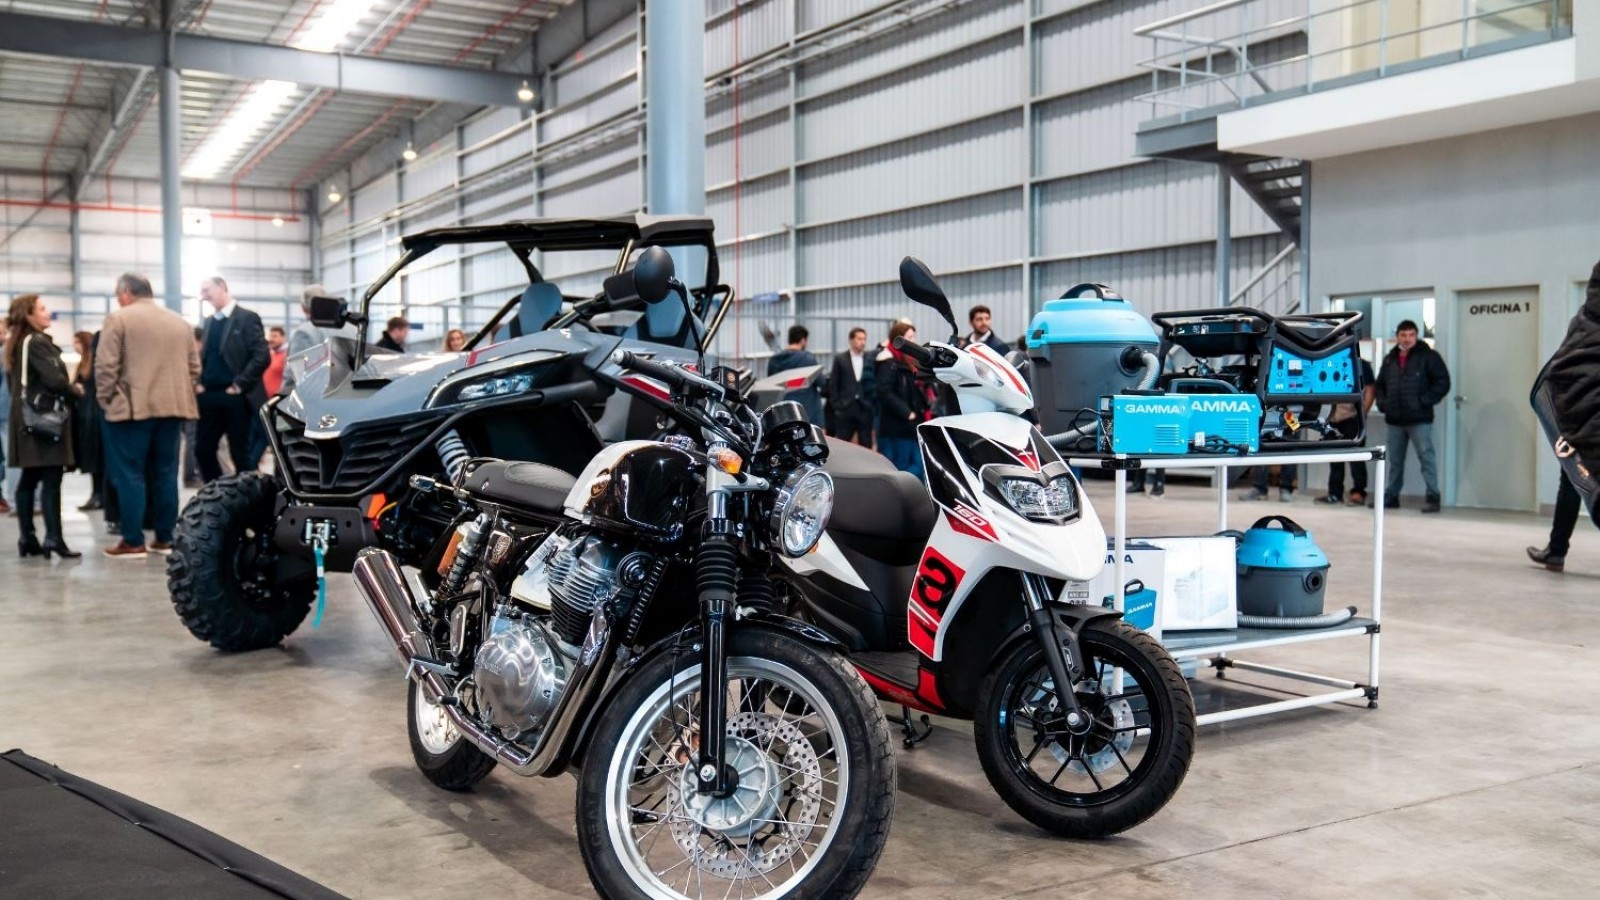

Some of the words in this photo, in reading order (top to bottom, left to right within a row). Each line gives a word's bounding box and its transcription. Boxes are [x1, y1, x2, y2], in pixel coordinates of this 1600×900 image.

[1469, 303, 1521, 315] OFICINA
[1524, 302, 1530, 312] 1
[1124, 403, 1181, 414] GAMMA
[1190, 400, 1252, 413] AMMA
[952, 504, 988, 527] 160
